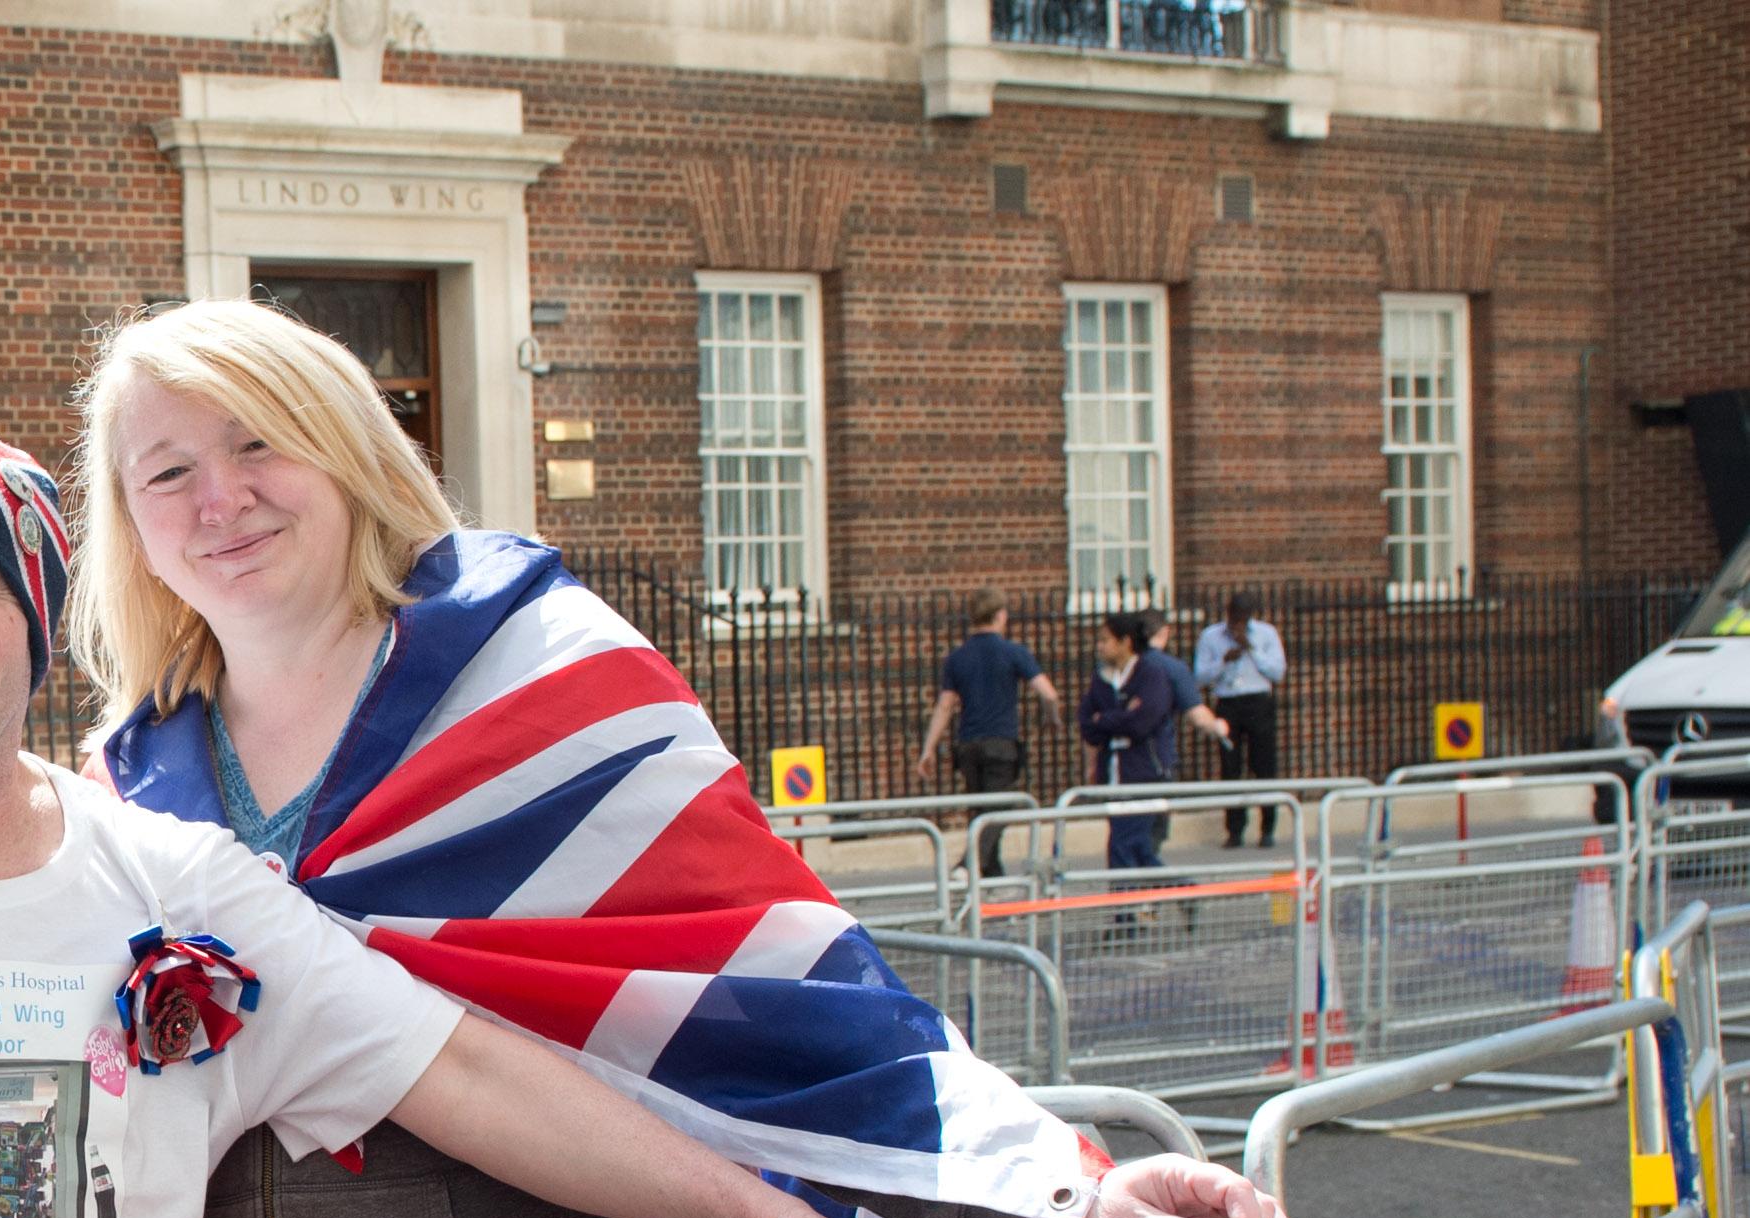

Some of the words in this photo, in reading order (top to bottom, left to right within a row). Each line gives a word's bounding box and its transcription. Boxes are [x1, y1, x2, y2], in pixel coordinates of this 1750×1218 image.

[238, 177, 361, 208] LINDO
[389, 183, 485, 212] WING
[10, 971, 86, 995] Hospital
[13, 1003, 65, 1029] Wing
[89, 1035, 117, 1058] Baby
